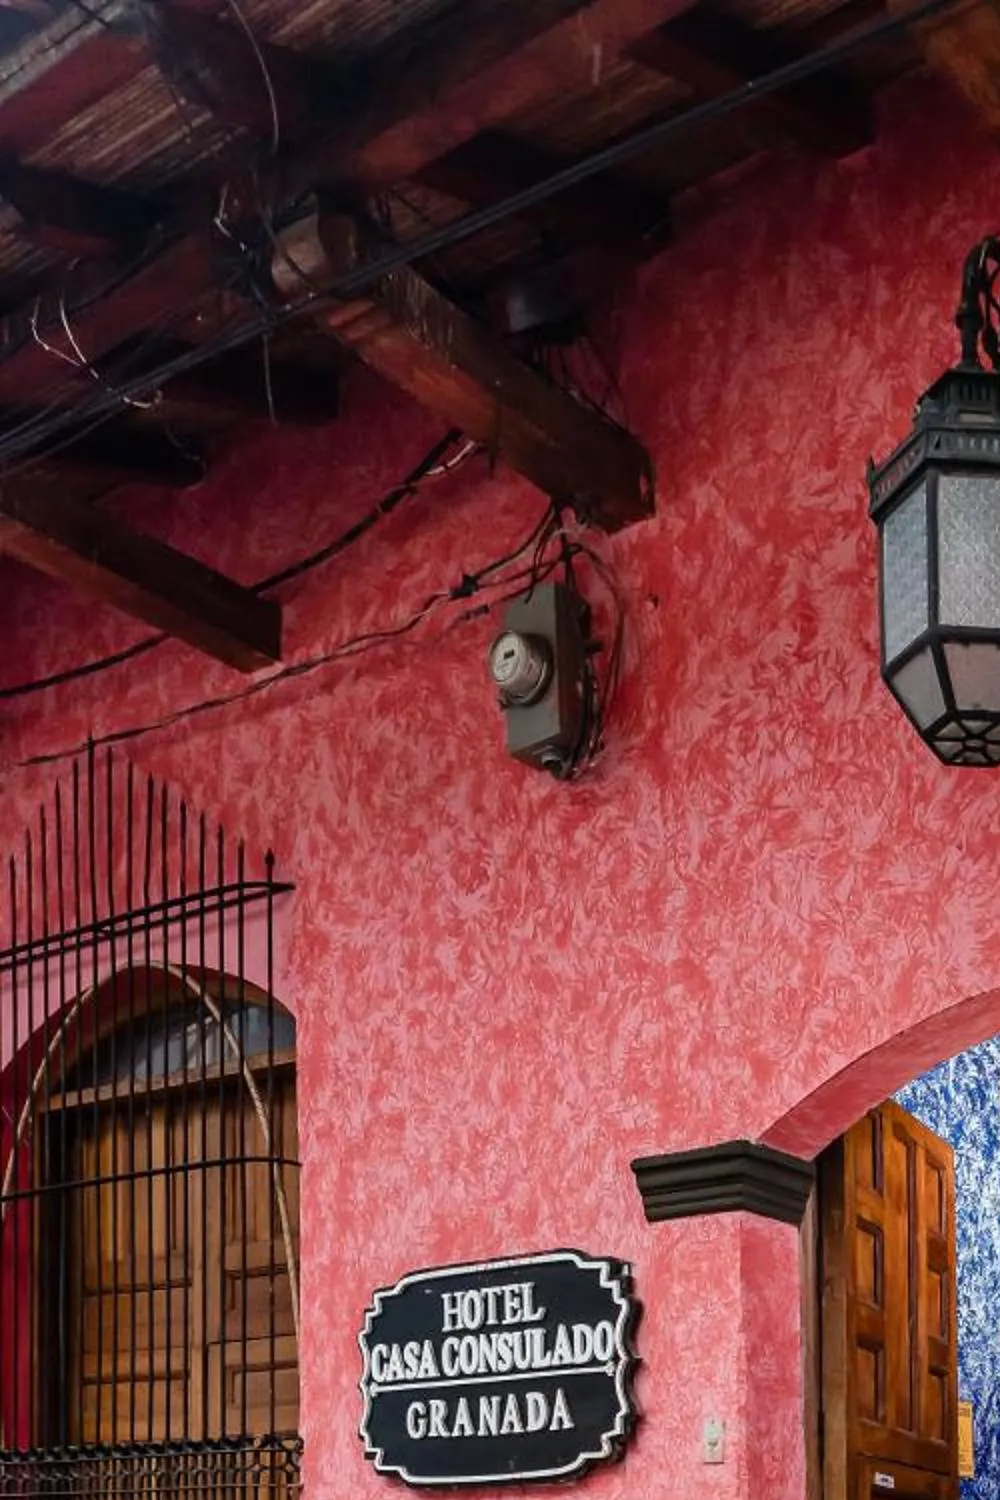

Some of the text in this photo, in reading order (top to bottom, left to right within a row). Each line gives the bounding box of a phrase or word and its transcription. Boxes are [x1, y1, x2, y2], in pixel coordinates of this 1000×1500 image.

[441, 1282, 546, 1332] HOTEL
[371, 1321, 614, 1382] CASA CONSULADO
[406, 1388, 575, 1439] GRANADA
